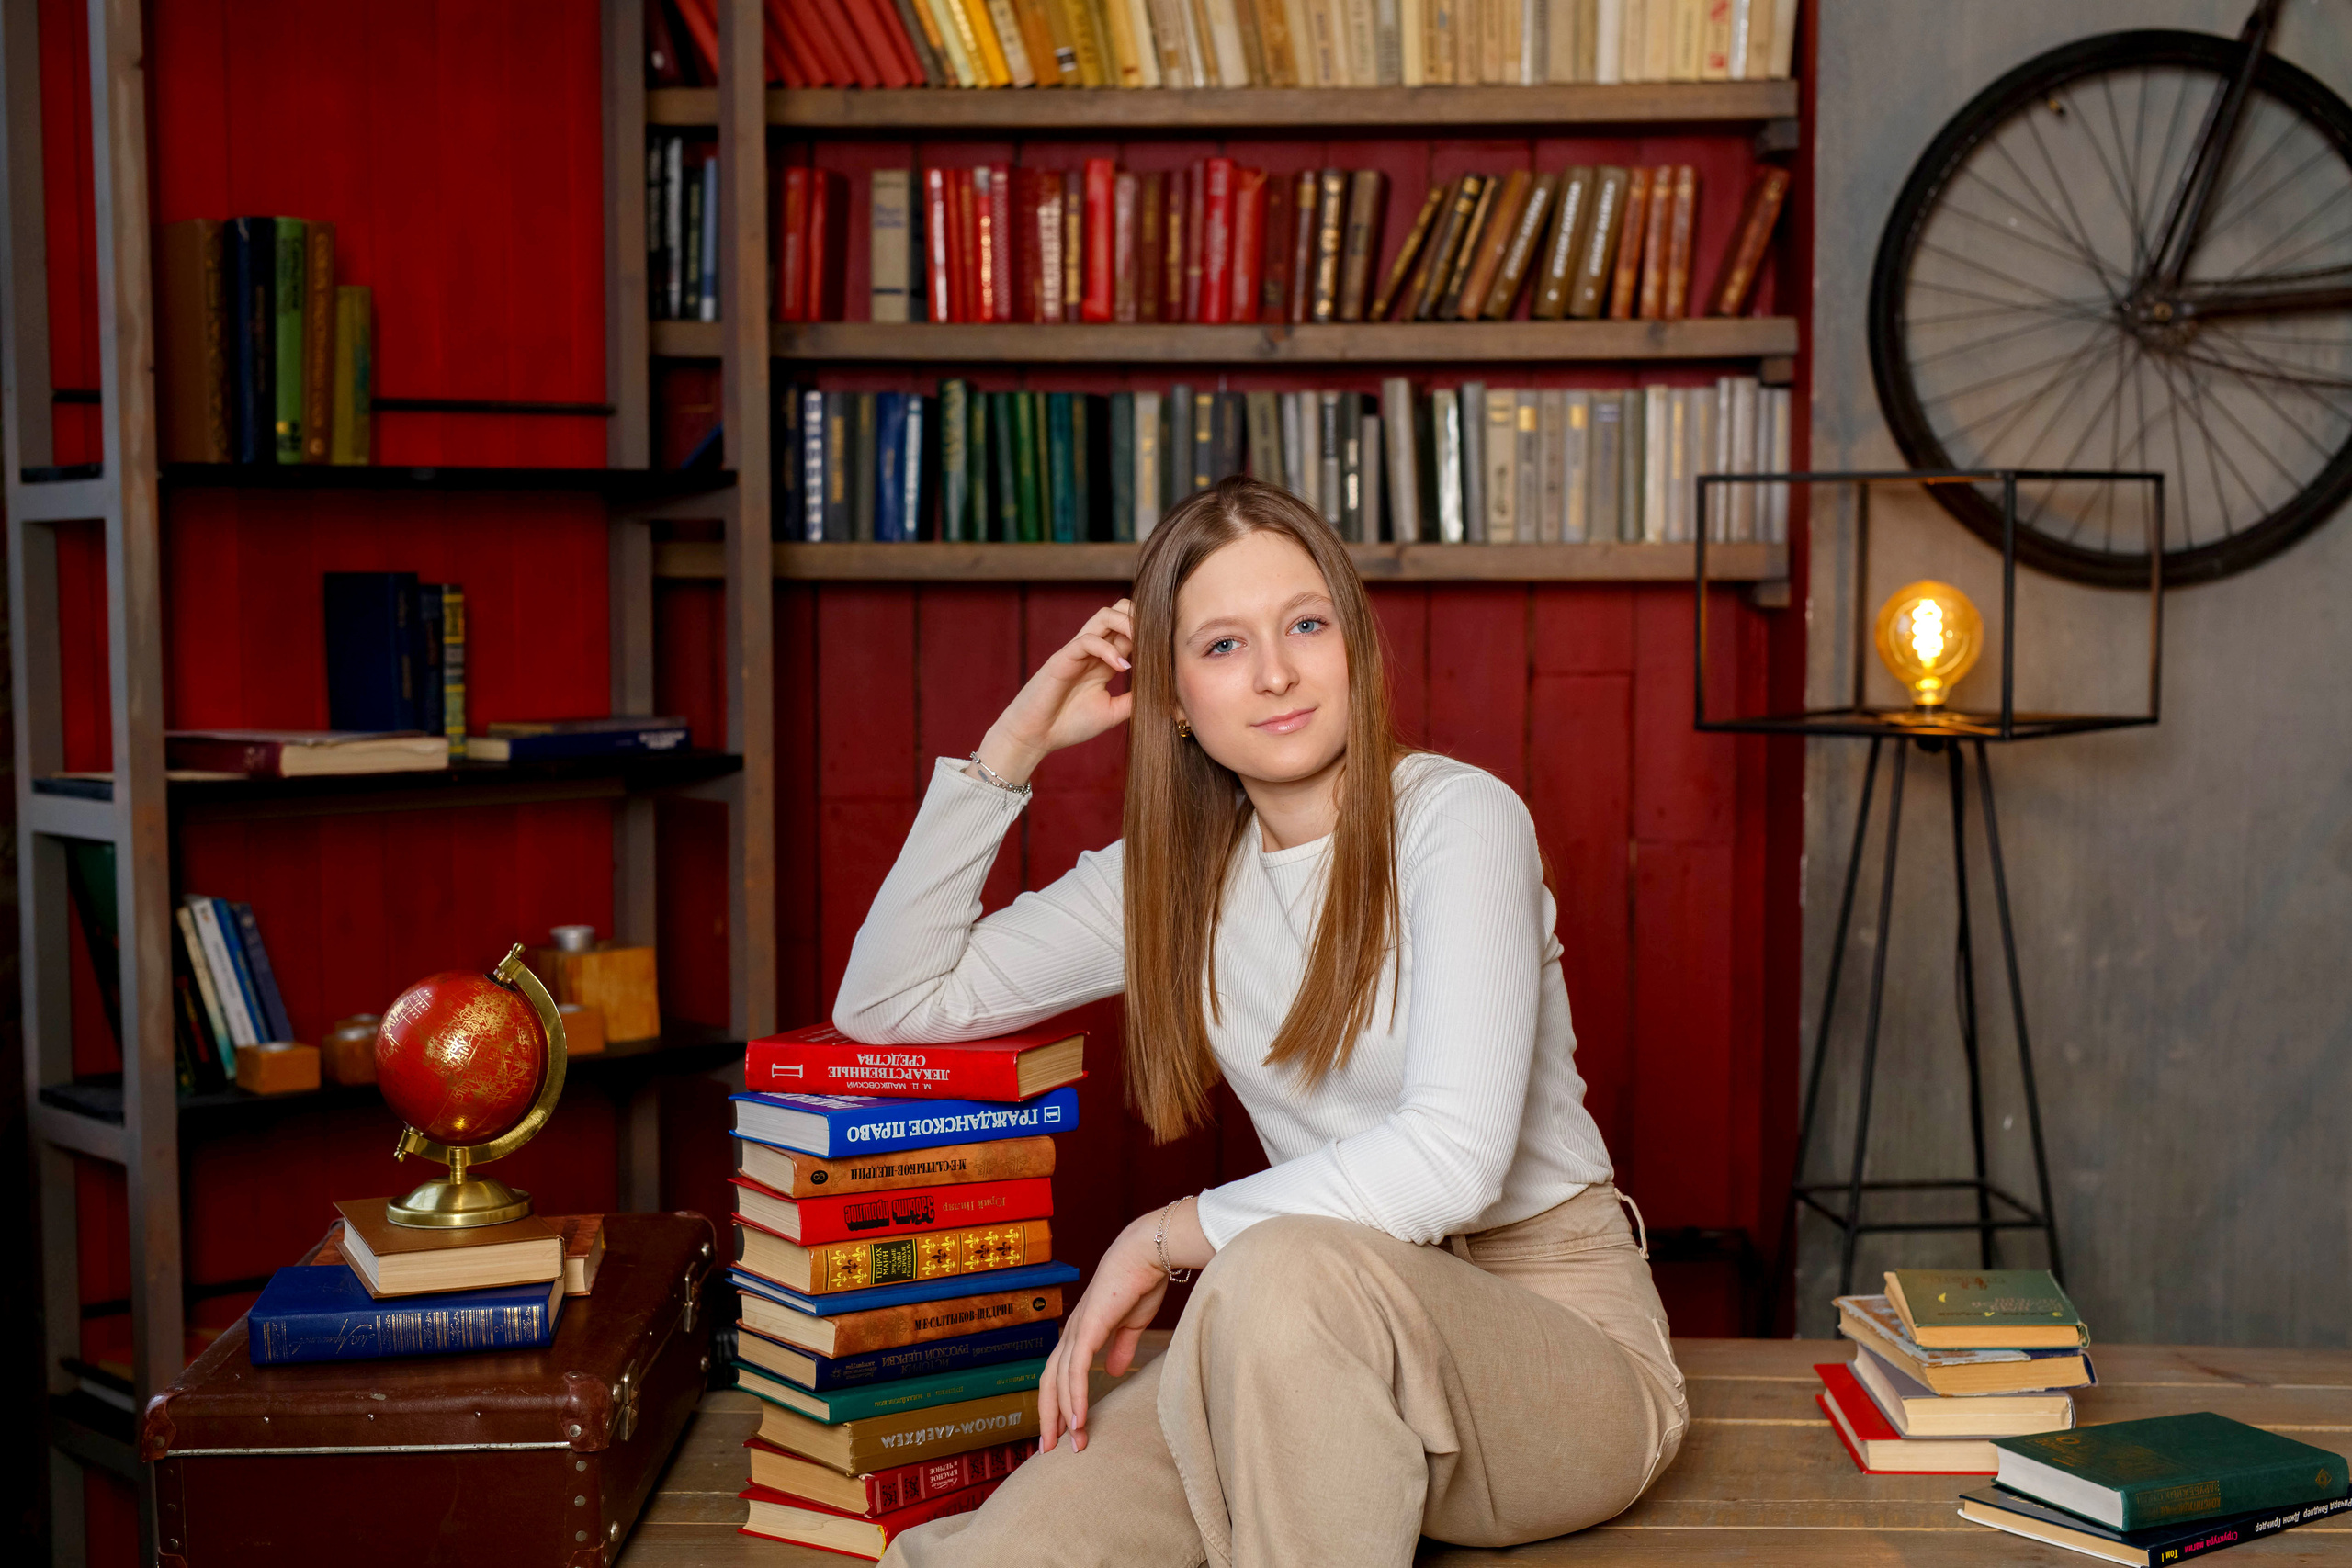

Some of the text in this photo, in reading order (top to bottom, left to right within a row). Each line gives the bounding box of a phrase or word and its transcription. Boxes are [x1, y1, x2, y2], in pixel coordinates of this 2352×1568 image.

[856, 1054, 926, 1066] СРЕДСТВА
[828, 1066, 950, 1080] ЛЕКАРСТВЕННЫЕ
[847, 1081, 906, 1089] МАШКОВСКИЙ
[847, 1109, 1038, 1142] ГРАЖДАНСКОЕ ПРАВО
[943, 1195, 1005, 1213] Юрий Пиляр
[843, 1195, 935, 1231] Забыть прошлое
[882, 1344, 969, 1367] РУССКОЙ ЦЕРКВИ
[901, 1358, 949, 1374] ИСТОРИЯ
[880, 1411, 1022, 1448] ШОЛОМ-АЛЕЙХЕМ
[929, 1462, 954, 1475] ЧЕРНОЕ
[930, 1469, 958, 1483] КРАСНОЕ
[2282, 1511, 2300, 1525] Джон
[2303, 1503, 2328, 1518] Бэндлер
[2255, 1517, 2280, 1532] Гриндер
[2185, 1530, 2238, 1553] Структура магии
[2165, 1549, 2178, 1560] Том
